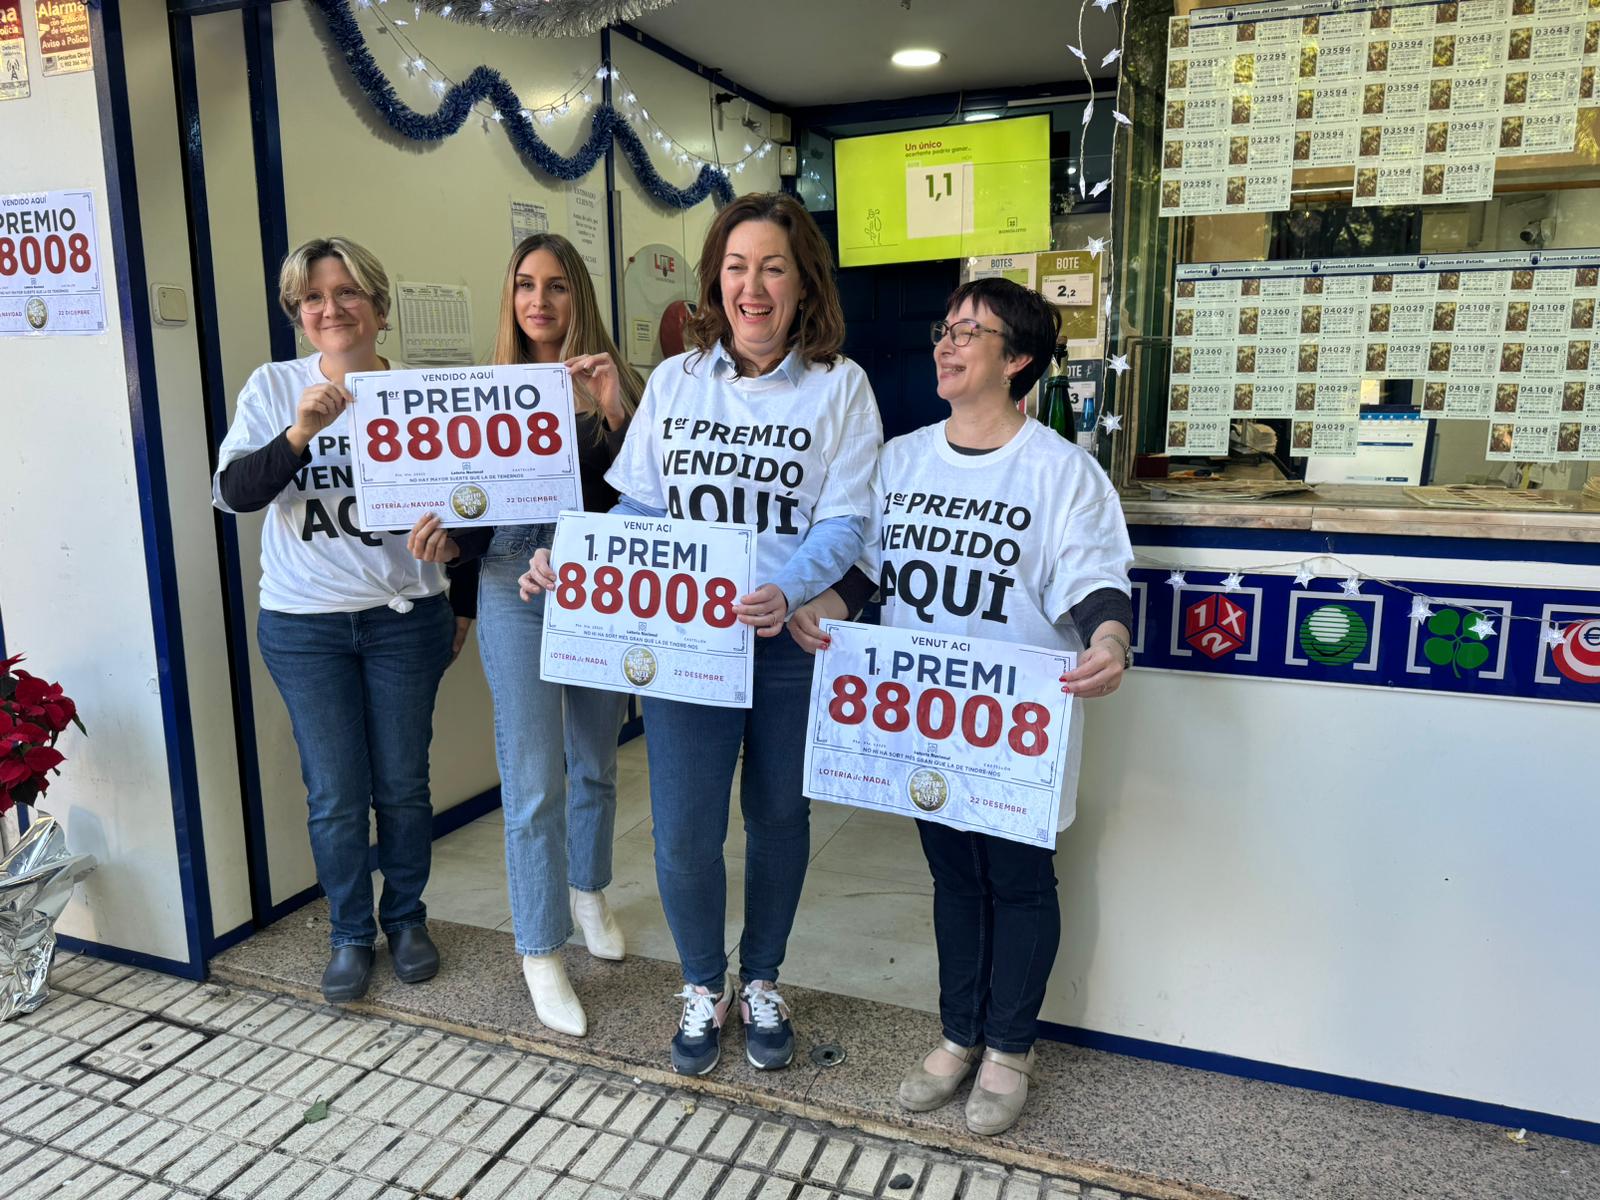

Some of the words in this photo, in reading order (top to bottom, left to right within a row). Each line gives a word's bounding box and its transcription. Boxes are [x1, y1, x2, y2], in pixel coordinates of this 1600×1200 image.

[39, 1, 85, 18] Alarma
[1535, 26, 1570, 36] 03643
[1458, 33, 1492, 44] 03643
[42, 39, 61, 49] Aviso
[1391, 40, 1423, 50] 03594
[1320, 46, 1351, 56] 03594
[1256, 52, 1286, 62] 02295
[1455, 78, 1488, 88] 03643
[1254, 94, 1284, 104] 02295
[1185, 139, 1214, 149] 02295
[1251, 135, 1281, 145] 02295
[905, 143, 917, 152] Un
[919, 140, 942, 150] único
[1183, 180, 1212, 189] 02295
[1248, 175, 1278, 185] 02295
[925, 172, 952, 201] 1,1
[3, 198, 30, 207] VENDIDO
[31, 195, 47, 205] AQUÍ
[0, 232, 91, 277] 8008
[991, 258, 1013, 268] BOTES
[1056, 257, 1080, 270] BOTE
[1057, 285, 1076, 299] 2,2
[1260, 308, 1290, 317] 02360
[1324, 306, 1354, 315] 04029
[1393, 304, 1425, 313] 04029
[1459, 303, 1491, 312] 04108
[1532, 303, 1566, 312] 04108
[1193, 347, 1222, 356] 02360
[1258, 346, 1287, 355] 02360
[1321, 345, 1351, 354] 04029
[1389, 344, 1421, 353] 04029
[1454, 344, 1486, 353] 04108
[1526, 345, 1560, 354] 04108
[1067, 365, 1082, 377] OTE
[421, 372, 467, 383] VENDIDO
[470, 370, 494, 381] AQUÍ
[1191, 385, 1220, 394] 02360
[1255, 384, 1285, 393] 02360
[1318, 384, 1348, 393] 04029
[1448, 384, 1480, 393] 04108
[1520, 385, 1554, 394] 04108
[376, 390, 400, 416] 1er
[404, 384, 541, 415] PREMIO
[1188, 422, 1217, 431] 02360
[1315, 422, 1345, 431] 04029
[1515, 425, 1549, 434] 04108
[366, 411, 563, 463] 88008
[663, 416, 689, 440] 1er
[690, 419, 812, 452] PREMIO
[663, 449, 804, 489] VENDIDO
[410, 500, 446, 508] NAVIDAD
[517, 495, 558, 503] DICIEMBRE
[883, 492, 908, 515] 1er
[906, 492, 1032, 531] PREMIO
[624, 521, 655, 532] VENUT
[656, 524, 672, 533] ACI
[881, 523, 1021, 567] VENDIDO
[607, 535, 708, 573] PREMI
[556, 561, 737, 629] 88008
[880, 560, 1015, 625] AQUÍ
[911, 636, 948, 649] VENUT
[950, 641, 971, 652] ACI
[550, 652, 577, 662] LOTERIA
[585, 656, 608, 666] NADAL
[673, 668, 683, 677] 22
[684, 669, 725, 682] DESEMBRE
[891, 650, 1017, 697] PREMI
[828, 674, 1051, 758] 88008
[917, 756, 933, 764] GRAN
[934, 759, 946, 767] QUE
[819, 767, 852, 780] LOTERIA
[852, 773, 862, 781] de
[863, 775, 891, 786] NADAL
[969, 795, 981, 805] 22
[982, 798, 1028, 815] DESEMBRE
